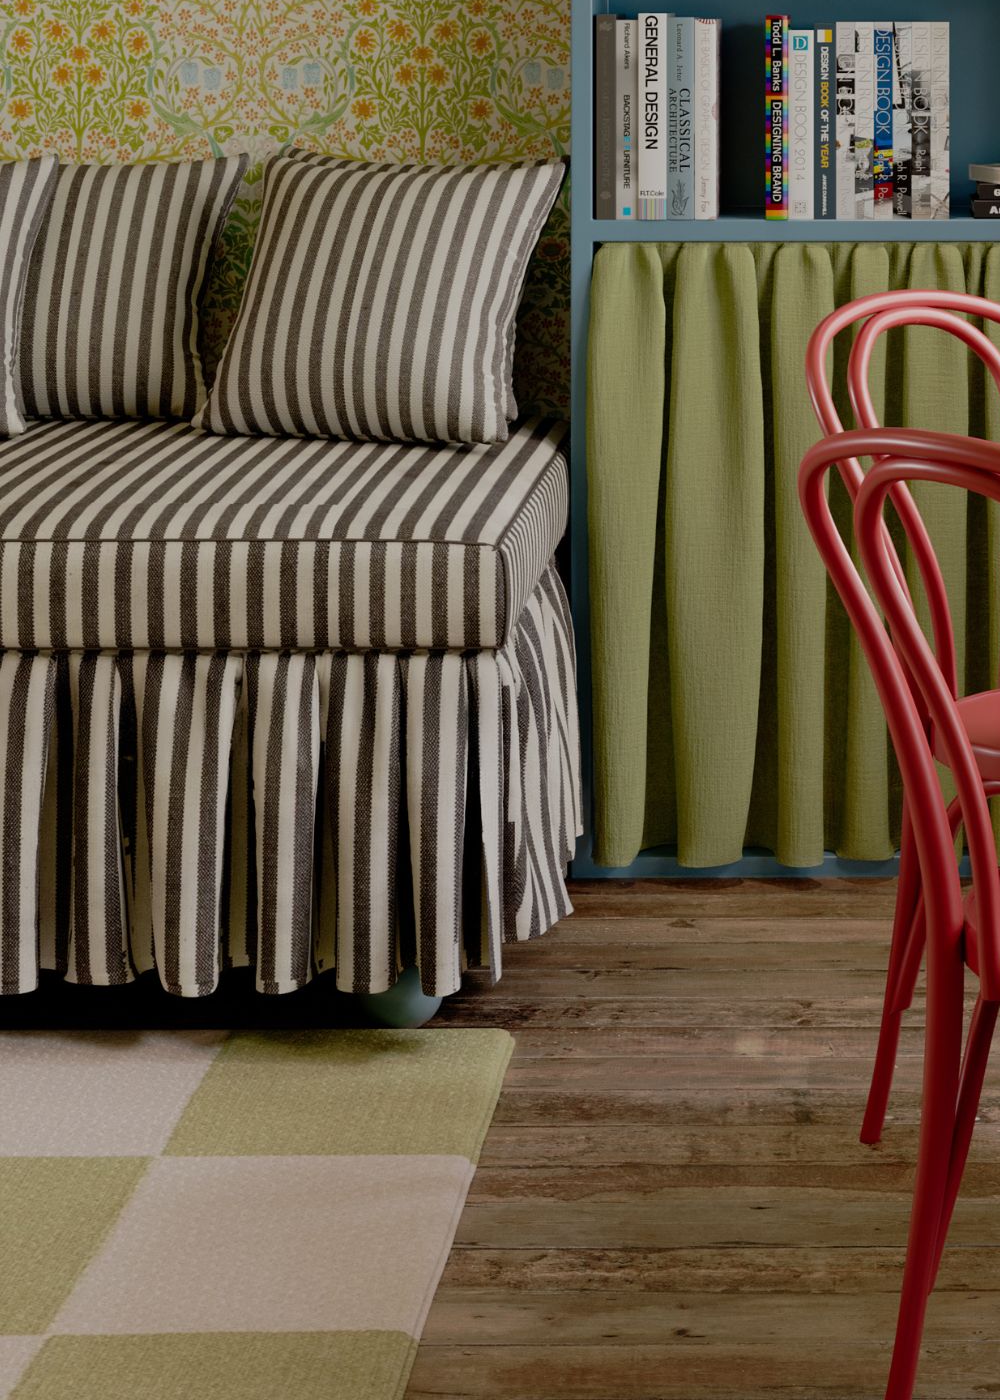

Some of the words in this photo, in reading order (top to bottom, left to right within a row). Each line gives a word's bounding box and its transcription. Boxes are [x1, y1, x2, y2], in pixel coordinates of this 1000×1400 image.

[645, 16, 658, 87] GENERAL
[772, 20, 781, 44] Todd
[772, 47, 781, 56] L.
[876, 30, 890, 82] DESIGN
[772, 61, 781, 91] Banks
[645, 92, 658, 149] DESIGN
[669, 89, 677, 172] ARCHITECTURE
[679, 89, 690, 172] CLASSICAL
[772, 102, 781, 162] DESIGNING
[876, 88, 890, 134] BOOK
[772, 166, 781, 202] BRAND
